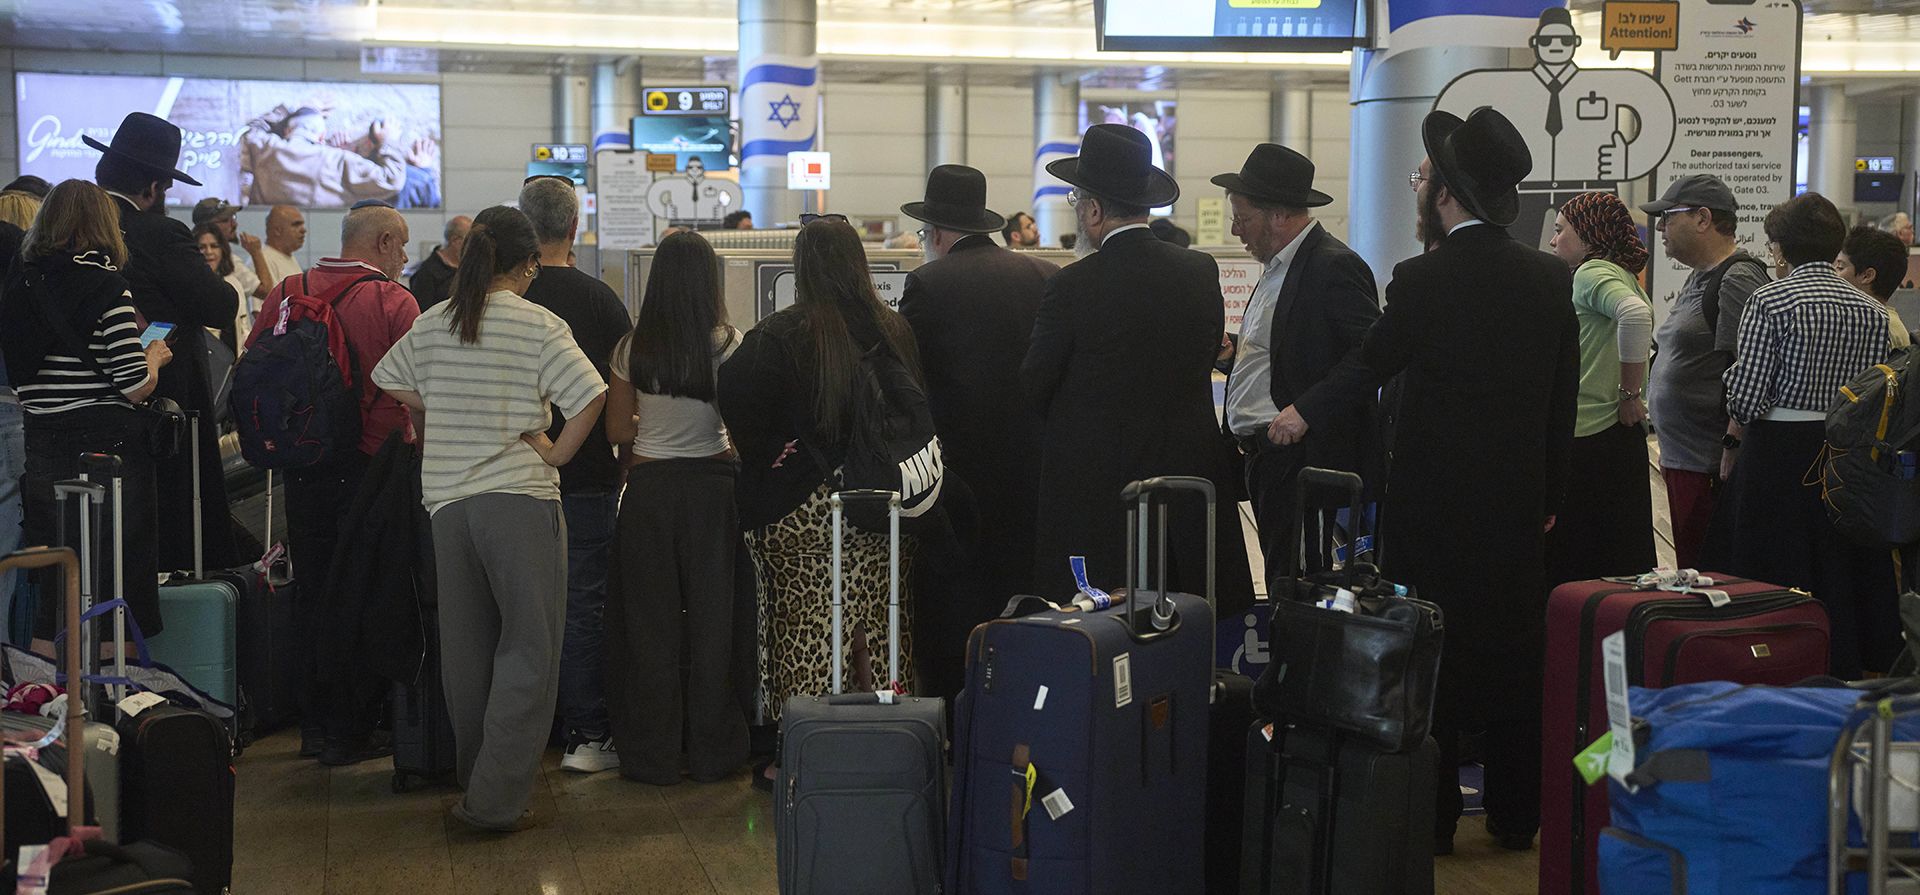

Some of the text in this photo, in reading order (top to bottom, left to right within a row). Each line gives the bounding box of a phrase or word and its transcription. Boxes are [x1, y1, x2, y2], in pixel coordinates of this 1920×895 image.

[1618, 12, 1665, 24] שימו לב!
[1610, 27, 1672, 39] Attention!
[1674, 63, 1697, 71] בשדה
[1763, 64, 1786, 72] שירות
[1673, 75, 1692, 83] Gett
[1730, 75, 1753, 84] מופעל
[1755, 76, 1786, 84] התעופה
[1692, 88, 1766, 97] בקומת הקרקע מחוץ
[678, 91, 693, 111] 9
[1727, 100, 1748, 108] לשער
[1678, 117, 1700, 125] לנסוע
[1702, 117, 1731, 126] להקפיד
[1745, 130, 1759, 138] ורק
[1761, 130, 1771, 138] אך
[26, 115, 86, 163] Gind
[552, 147, 568, 160] 10
[1690, 149, 1763, 159] Dear passengers,
[1672, 161, 1782, 170] The authorized taxi service
[1868, 159, 1881, 171] 10
[1669, 174, 1677, 182] at
[1725, 174, 1731, 182] is
[1733, 174, 1771, 183] operated
[1772, 174, 1783, 184] by
[1734, 186, 1754, 194] Gate
